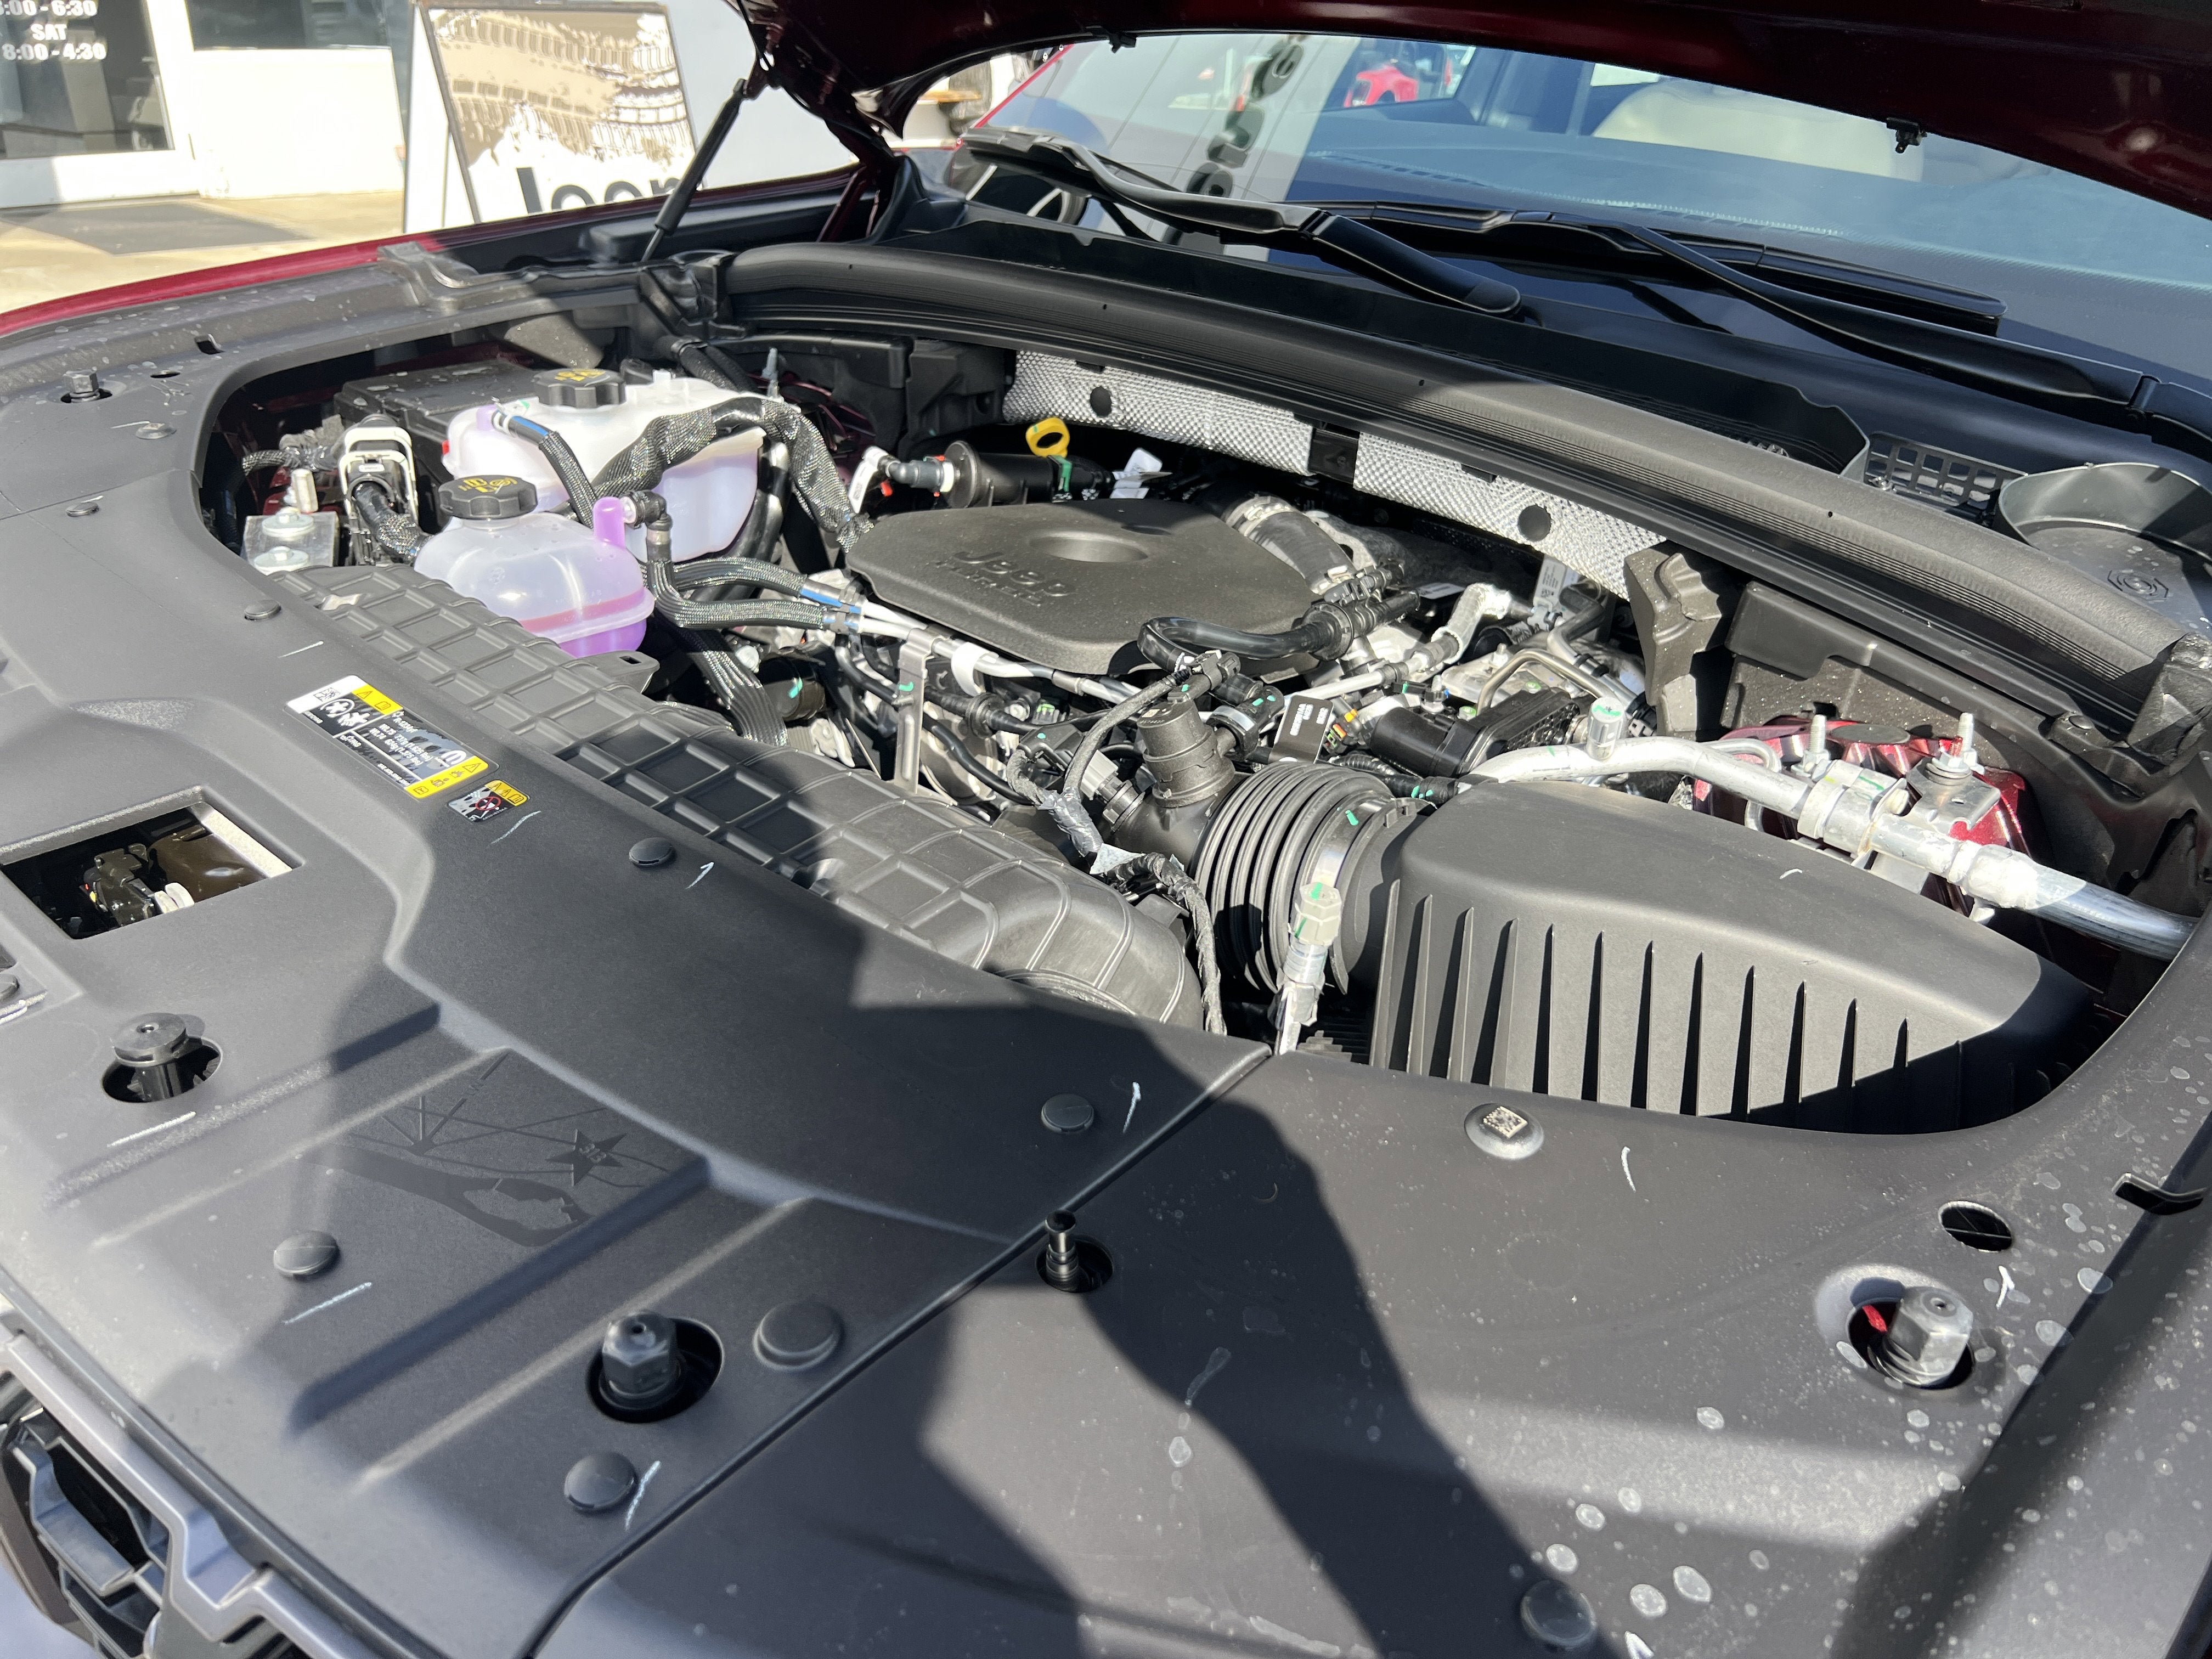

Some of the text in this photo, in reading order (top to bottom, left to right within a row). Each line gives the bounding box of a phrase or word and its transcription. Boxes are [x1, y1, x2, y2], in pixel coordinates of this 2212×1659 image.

[52, 0, 97, 16] 6:30
[31, 24, 67, 40] SAT
[2, 43, 49, 60] 8:00
[63, 43, 107, 60] 4:30
[953, 551, 1076, 598] Jeep
[579, 1143, 606, 1163] 313
